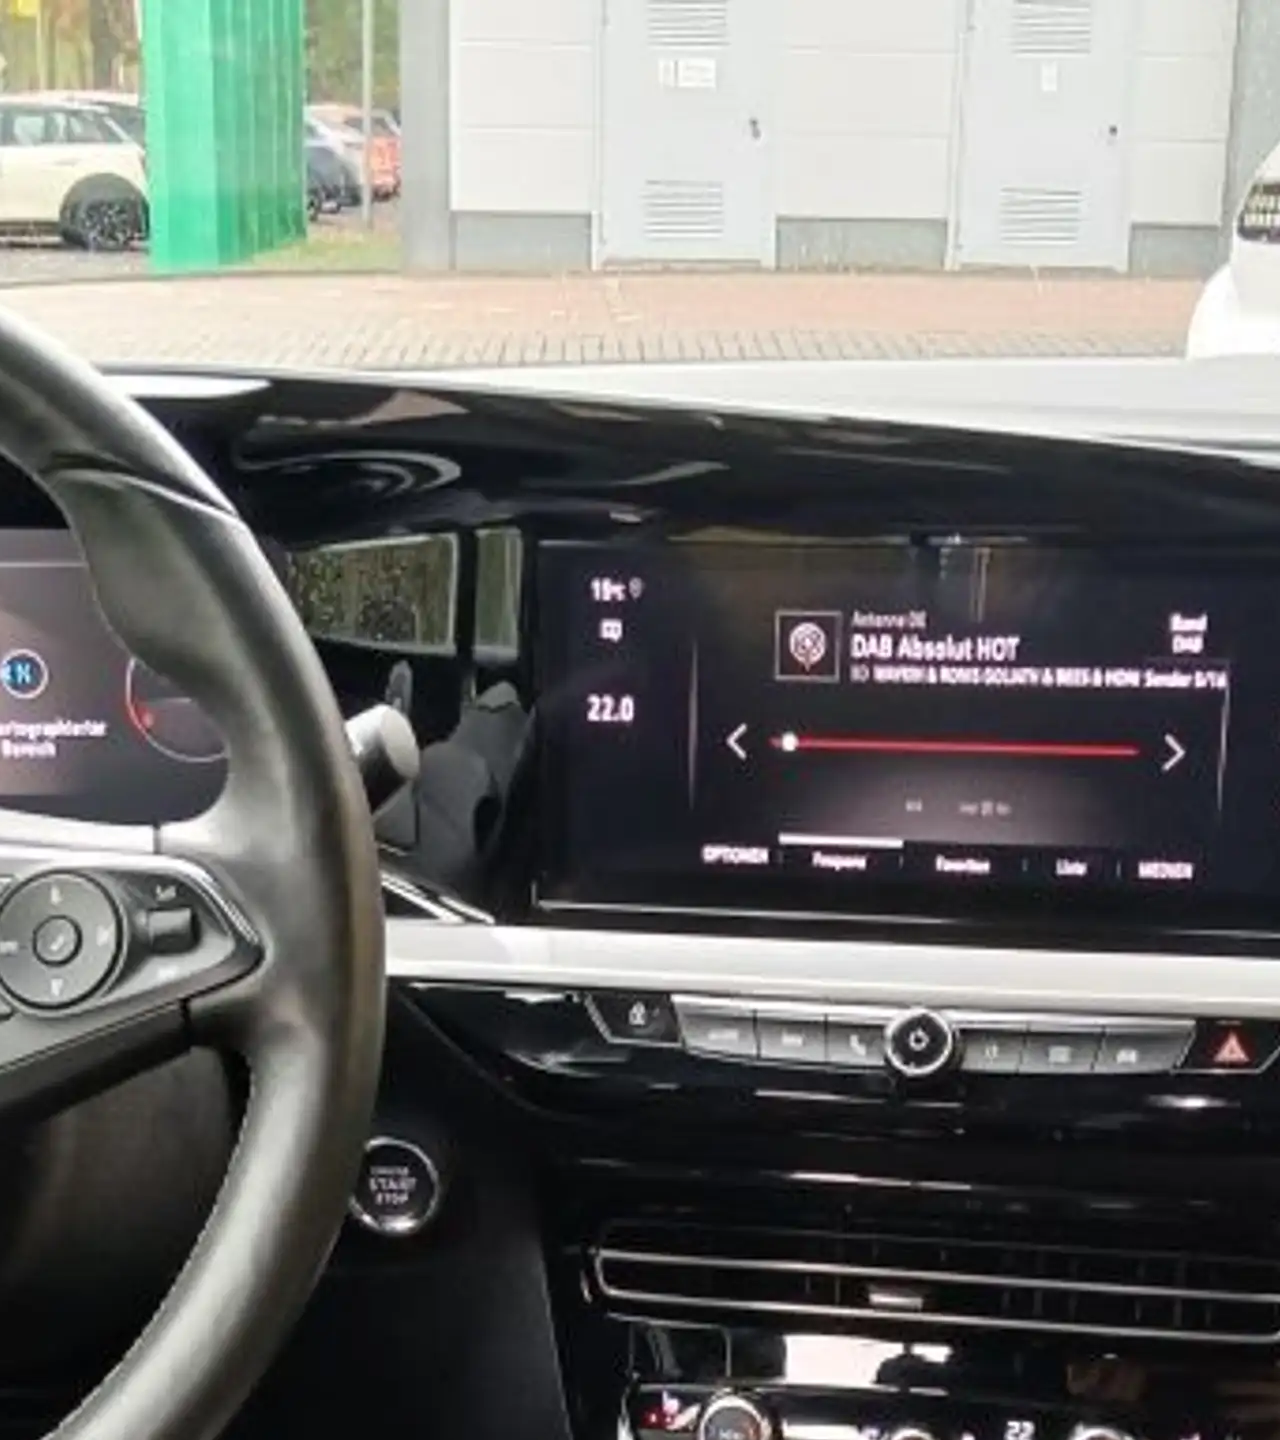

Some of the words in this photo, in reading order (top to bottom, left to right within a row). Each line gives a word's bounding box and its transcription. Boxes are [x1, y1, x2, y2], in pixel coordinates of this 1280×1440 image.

[850, 633, 893, 659] DAB
[898, 633, 974, 661] Absolut
[976, 636, 1021, 661] HOT
[587, 694, 635, 721] 22.0
